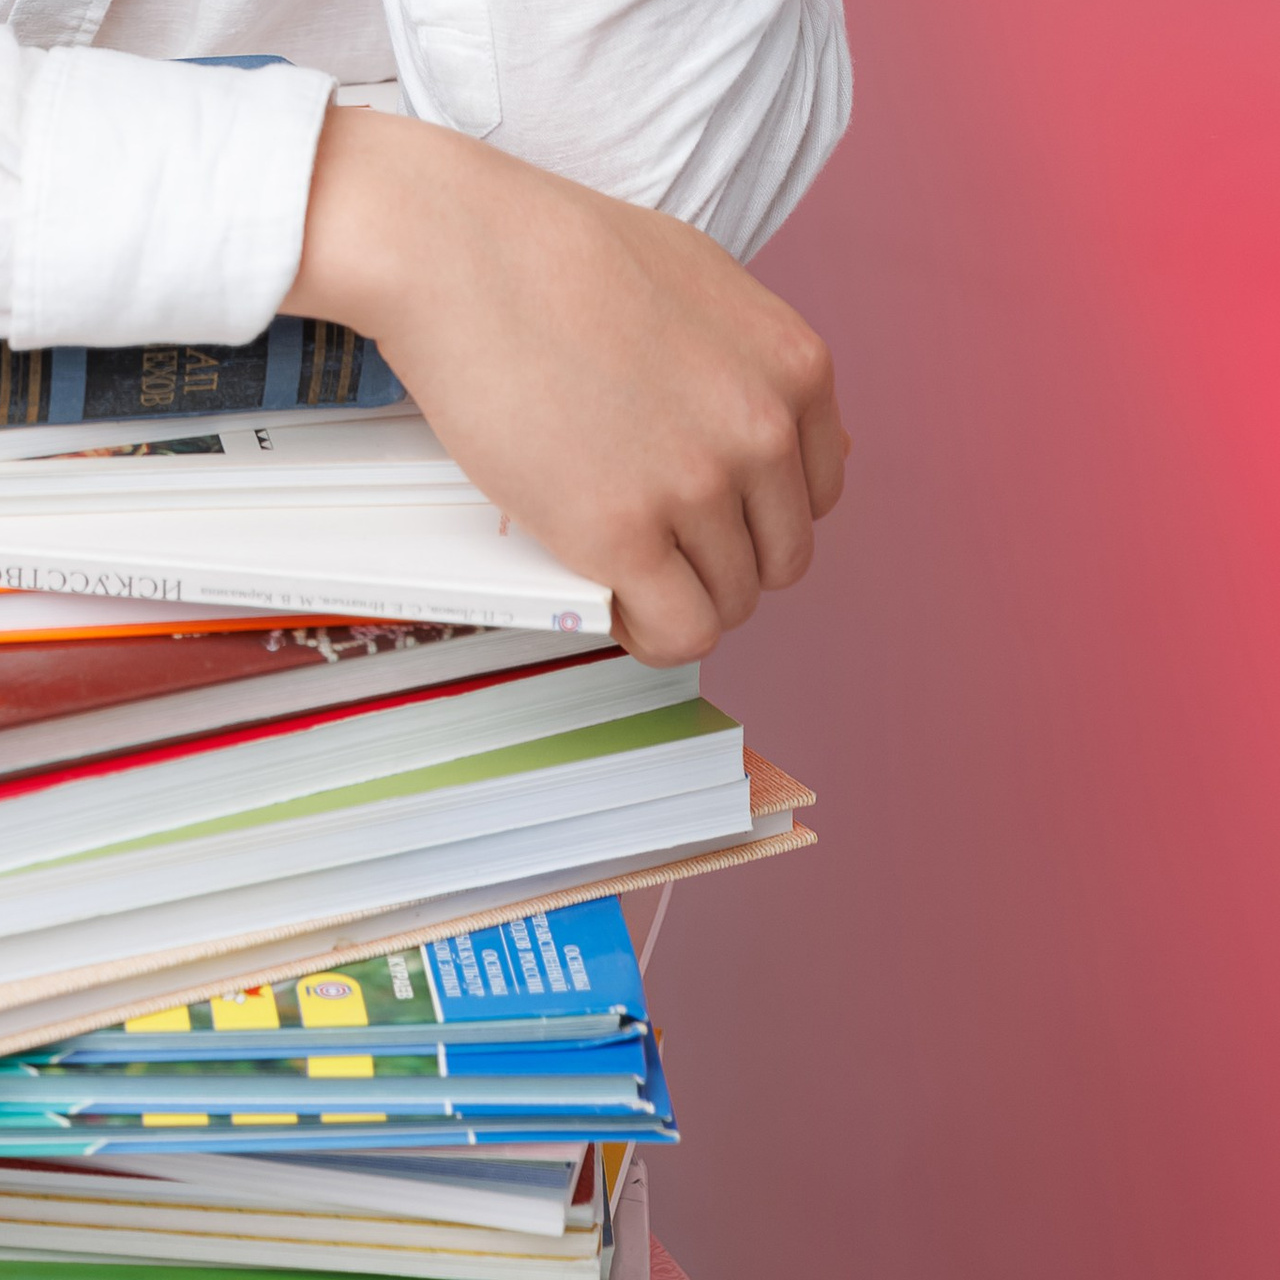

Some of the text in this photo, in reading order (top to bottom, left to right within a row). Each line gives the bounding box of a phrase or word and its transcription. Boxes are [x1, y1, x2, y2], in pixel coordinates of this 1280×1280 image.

[141, 343, 178, 407] ЕХОВ
[387, 955, 414, 999] КУРАЕВ
[438, 961, 461, 997] ЭТИКИ
[481, 949, 508, 995] ОСНОВЫ
[518, 951, 545, 994] РОССИИ
[563, 945, 591, 991] ОСНОВЫ
